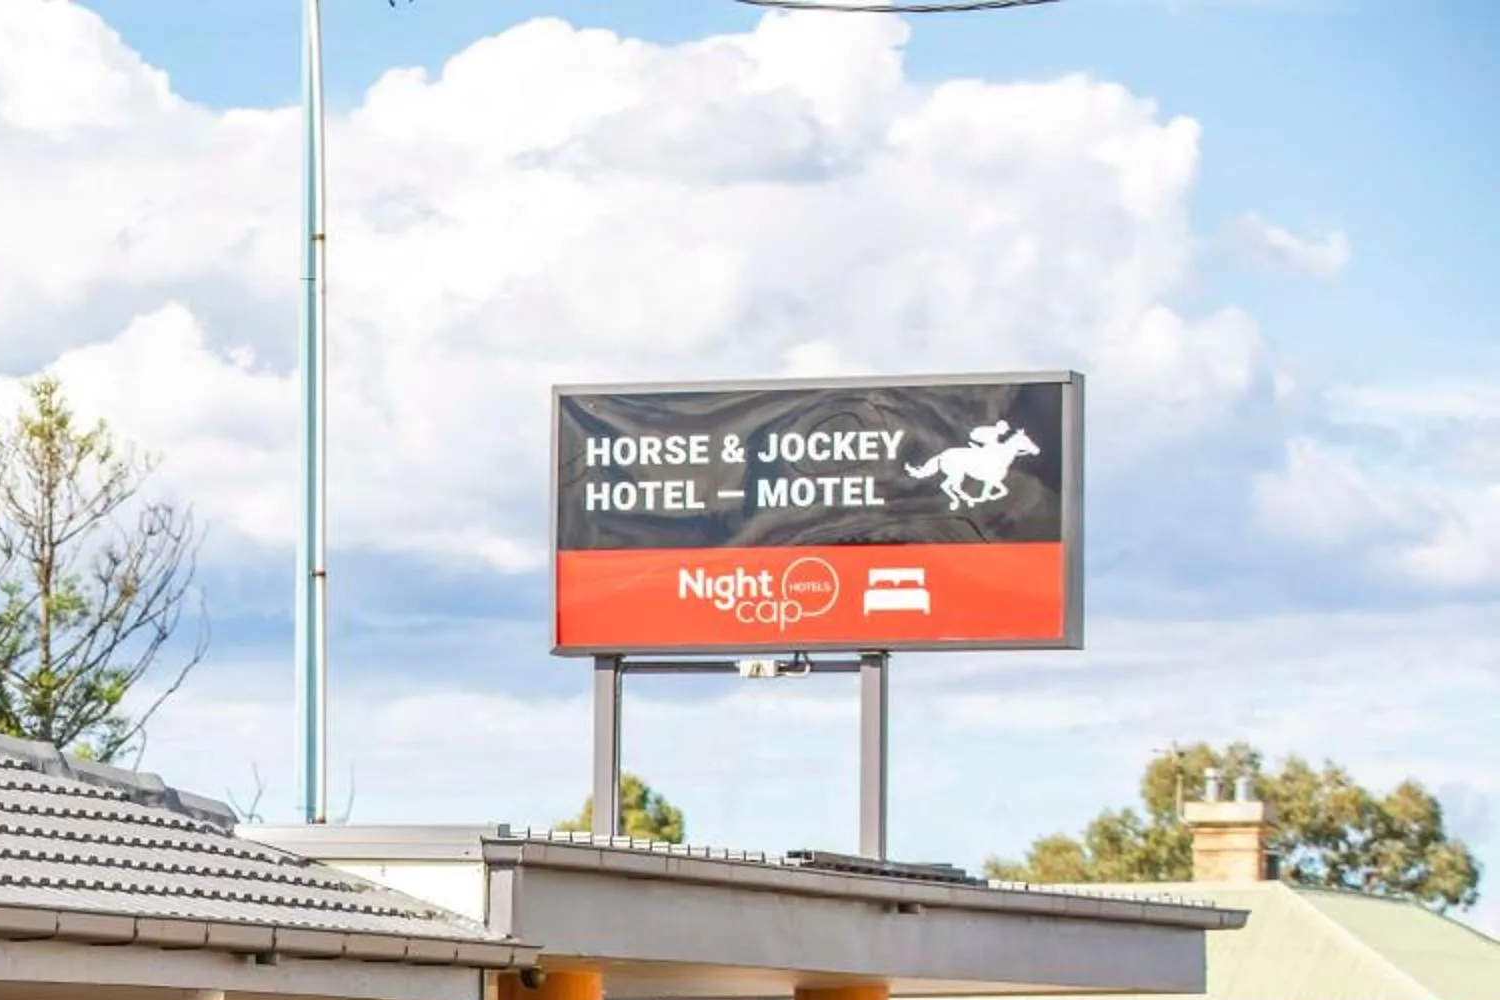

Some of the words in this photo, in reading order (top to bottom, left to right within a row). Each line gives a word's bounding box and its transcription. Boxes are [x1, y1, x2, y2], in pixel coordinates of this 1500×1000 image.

[586, 435, 710, 467] HORSE
[720, 434, 746, 464] &
[757, 430, 904, 463] JOCKEY
[586, 481, 705, 511] HOTEL
[757, 476, 885, 508] MOTEL
[678, 567, 773, 611] Night
[735, 598, 802, 631] cap
